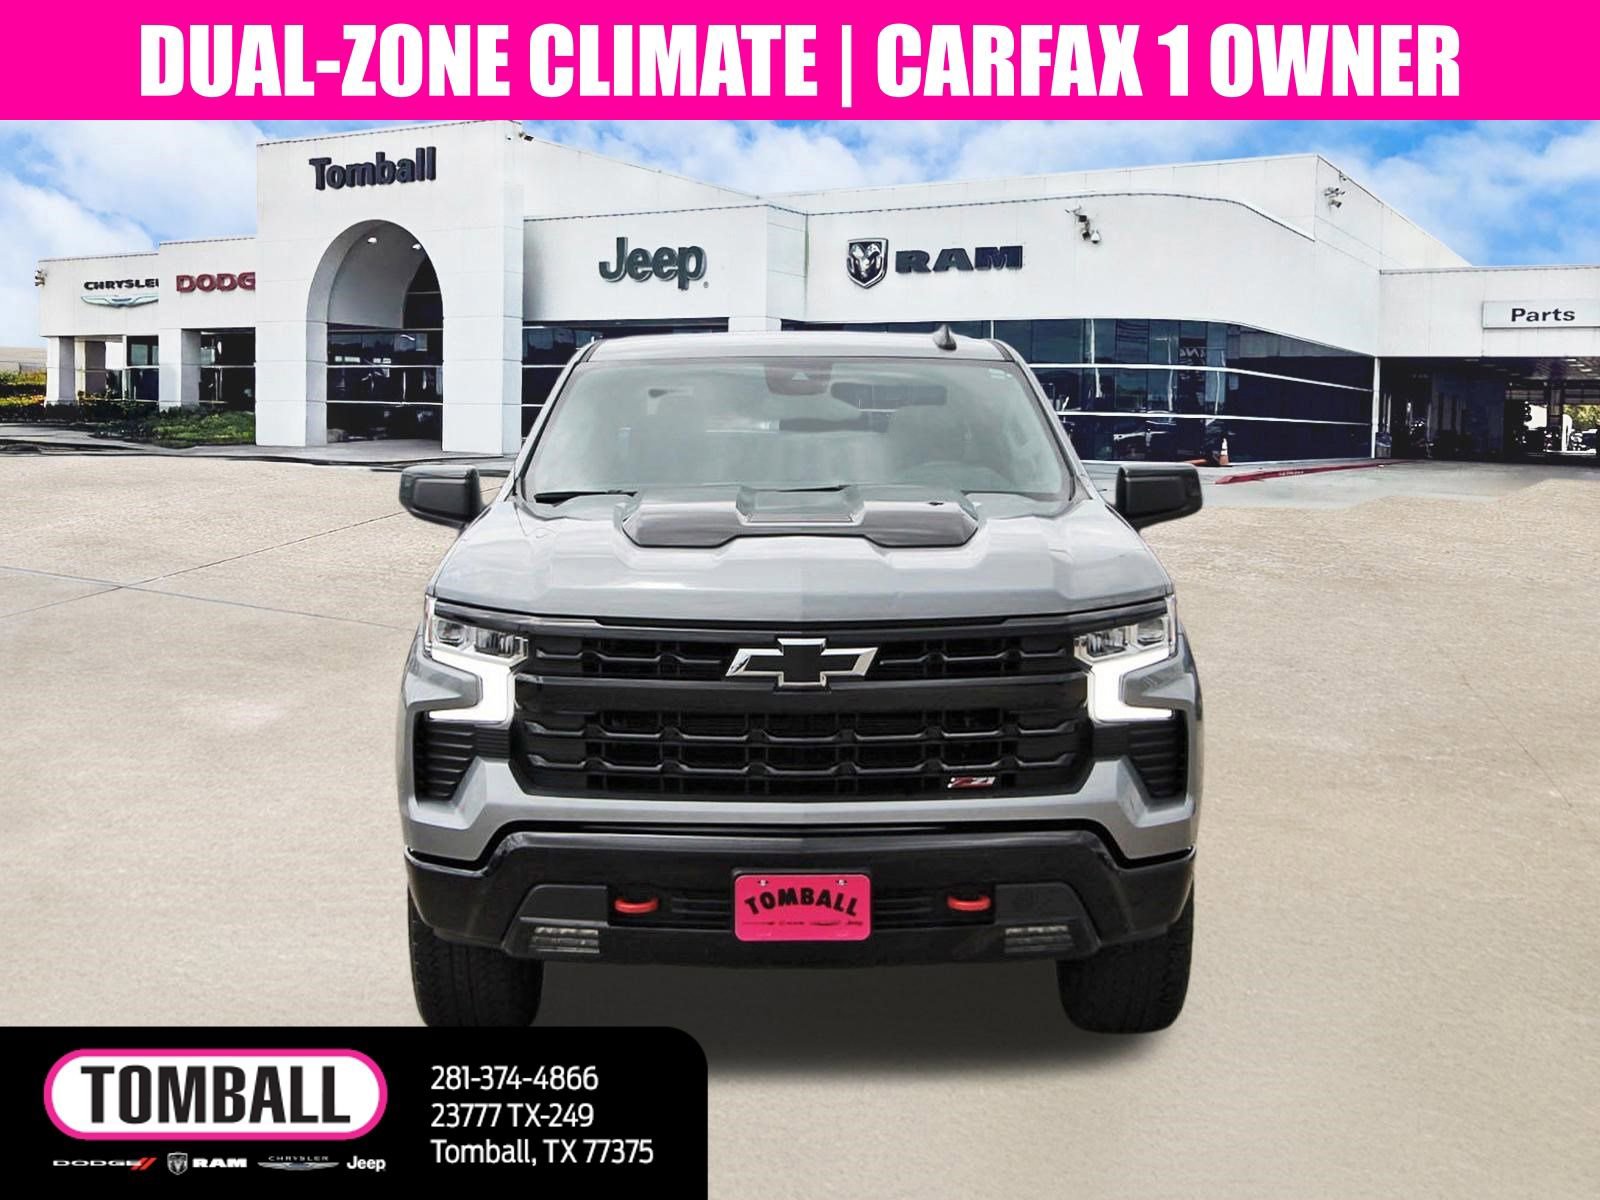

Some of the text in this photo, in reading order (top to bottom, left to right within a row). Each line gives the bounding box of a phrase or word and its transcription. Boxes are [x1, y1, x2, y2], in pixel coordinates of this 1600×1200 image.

[309, 146, 437, 191] Tomball
[599, 236, 707, 290] Jeep
[895, 245, 1024, 275] RAM
[83, 278, 160, 291] CHRYSLE
[1510, 307, 1576, 323] Parts
[744, 886, 858, 917] TOMBALL
